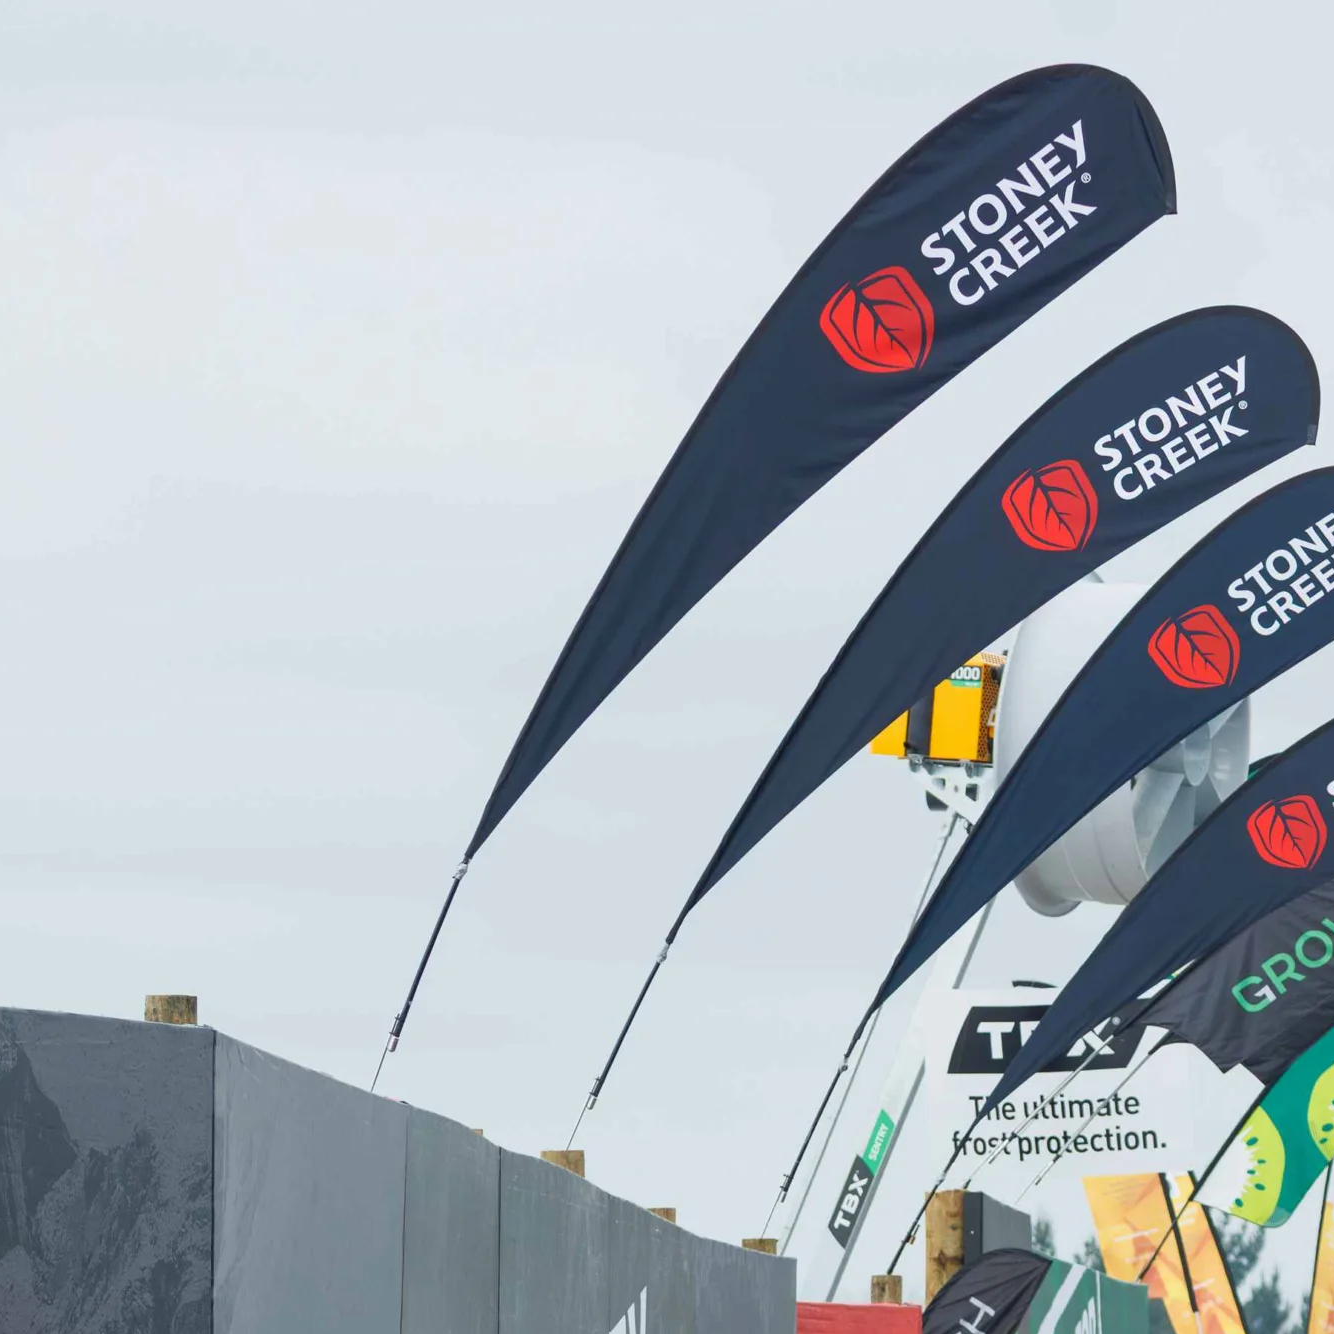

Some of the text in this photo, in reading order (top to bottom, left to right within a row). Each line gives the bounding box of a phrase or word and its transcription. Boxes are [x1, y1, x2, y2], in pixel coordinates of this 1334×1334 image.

[921, 119, 1087, 275] STONEY
[1094, 356, 1248, 472] STONEY
[977, 1017, 1115, 1060] TX
[969, 1093, 1139, 1120] The ultimate
[868, 1124, 889, 1163] SENTRY
[952, 1128, 1167, 1161] frost protection.
[834, 1174, 869, 1229] TBX
